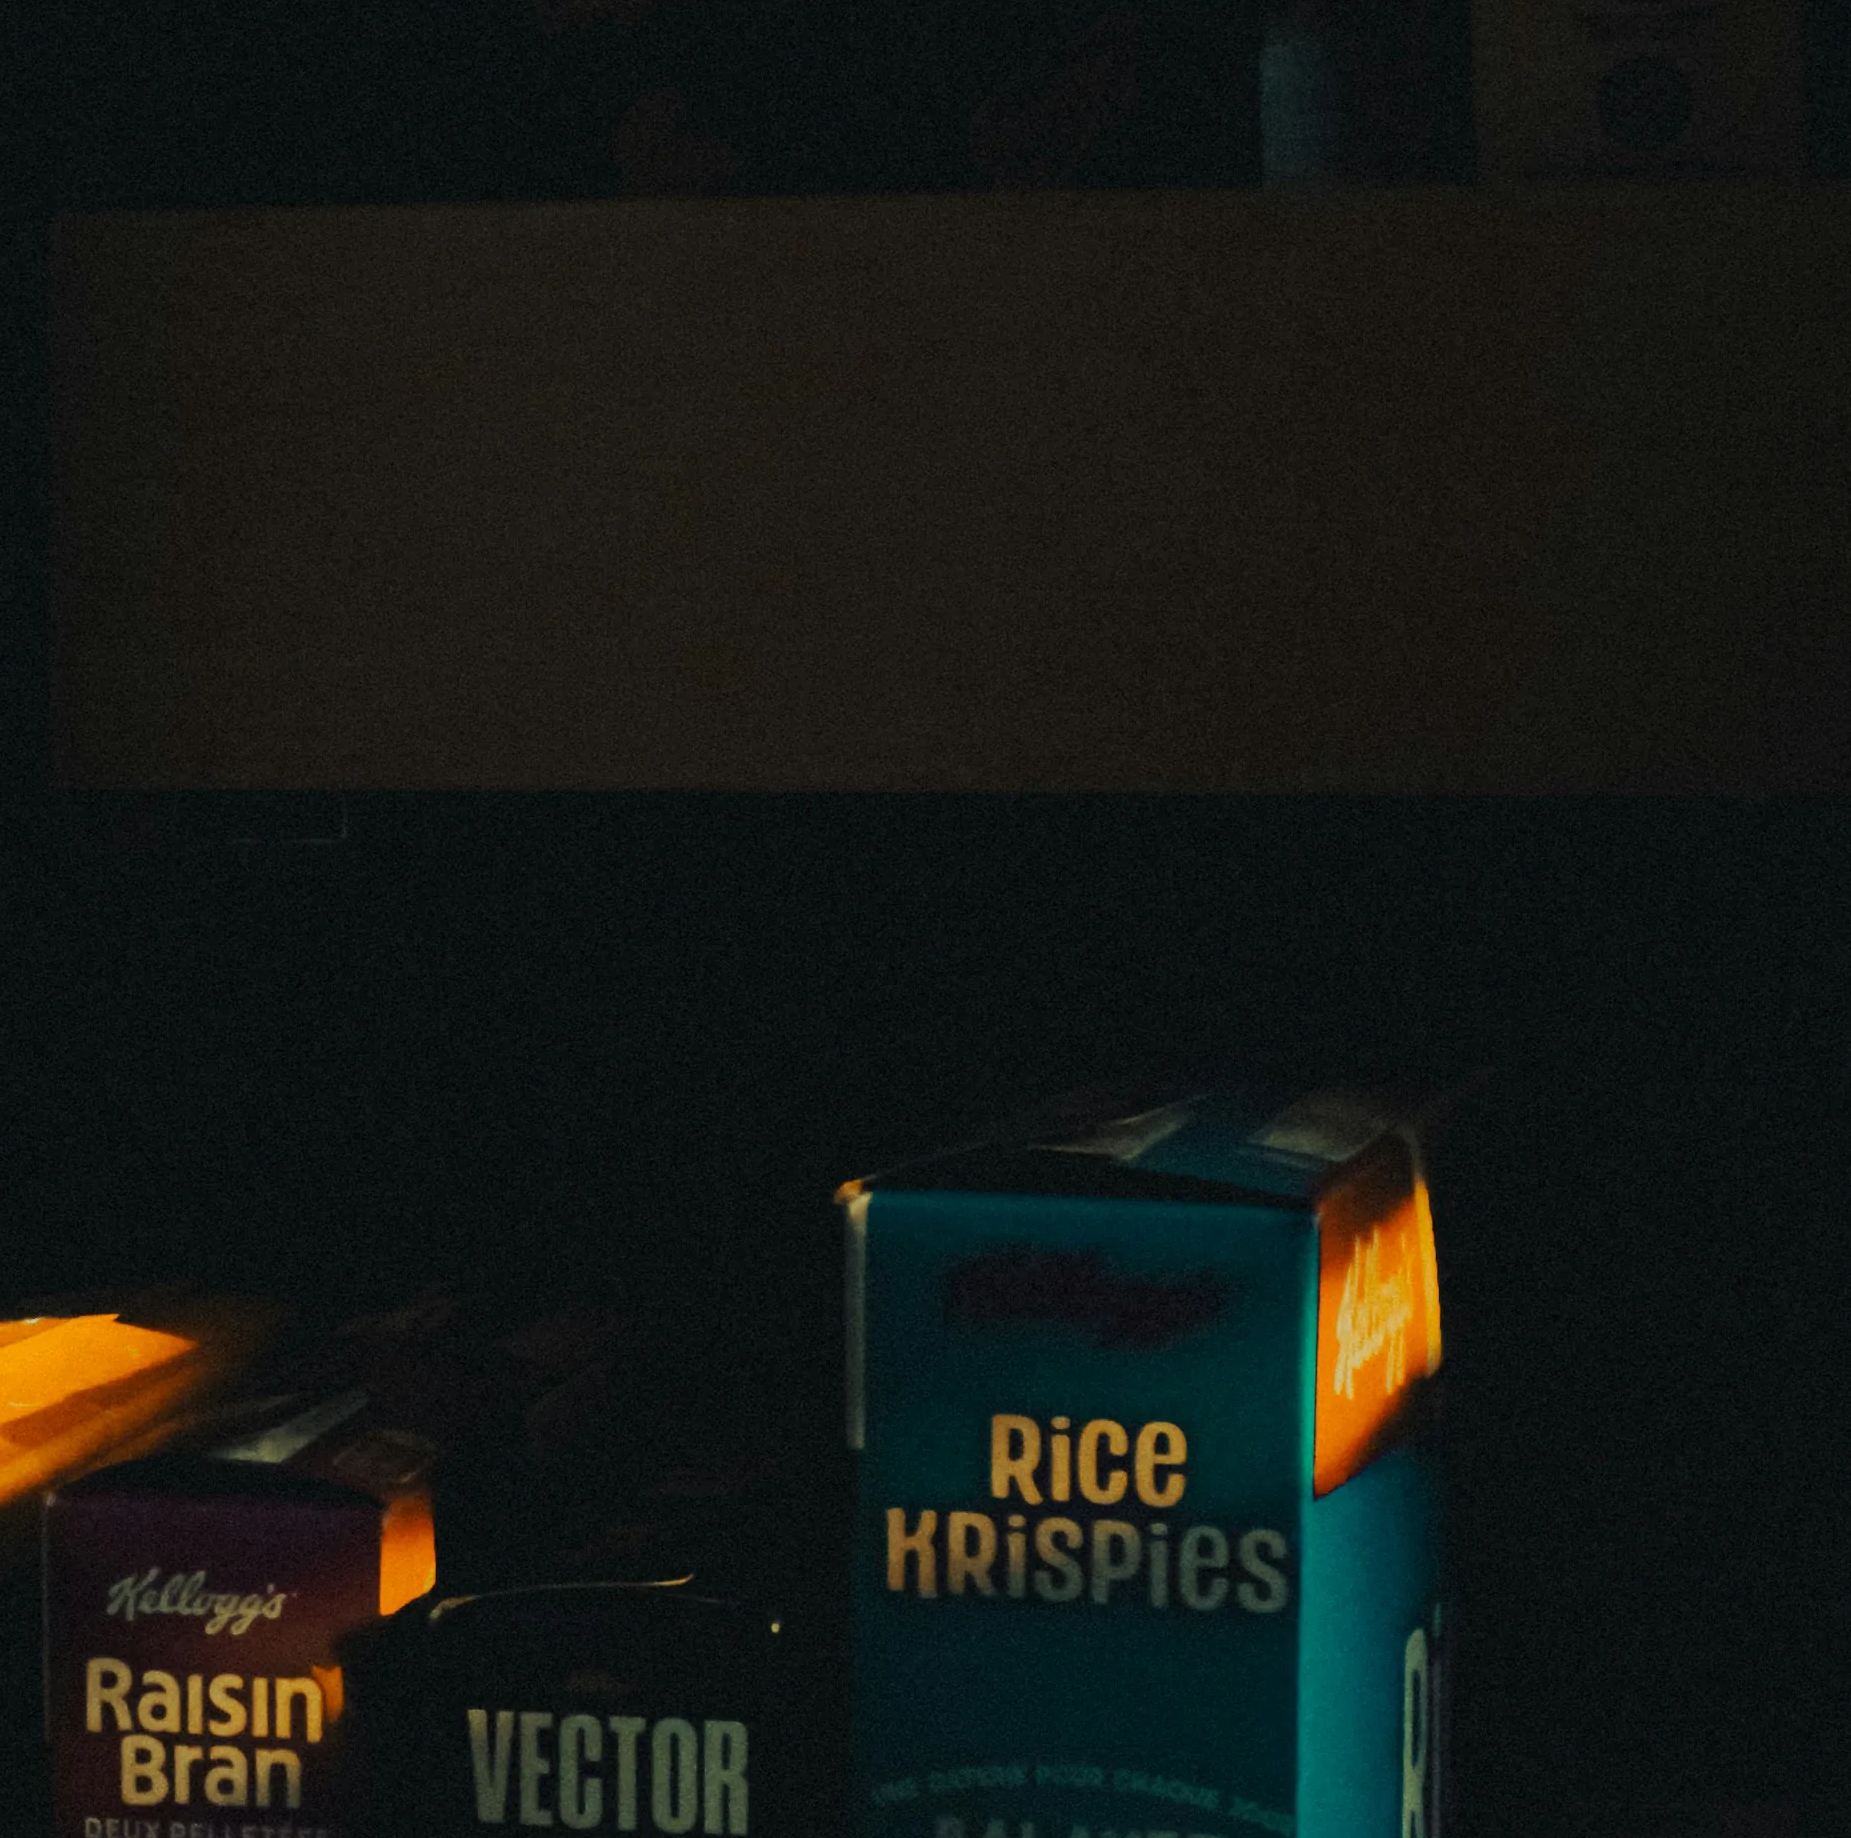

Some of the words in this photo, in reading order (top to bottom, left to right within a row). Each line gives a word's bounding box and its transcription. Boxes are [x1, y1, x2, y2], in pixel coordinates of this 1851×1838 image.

[103, 1564, 286, 1636] Kellogg's
[83, 1655, 326, 1745] Raisin
[118, 1734, 302, 1810] Bran
[466, 1708, 749, 1837] VECTOR
